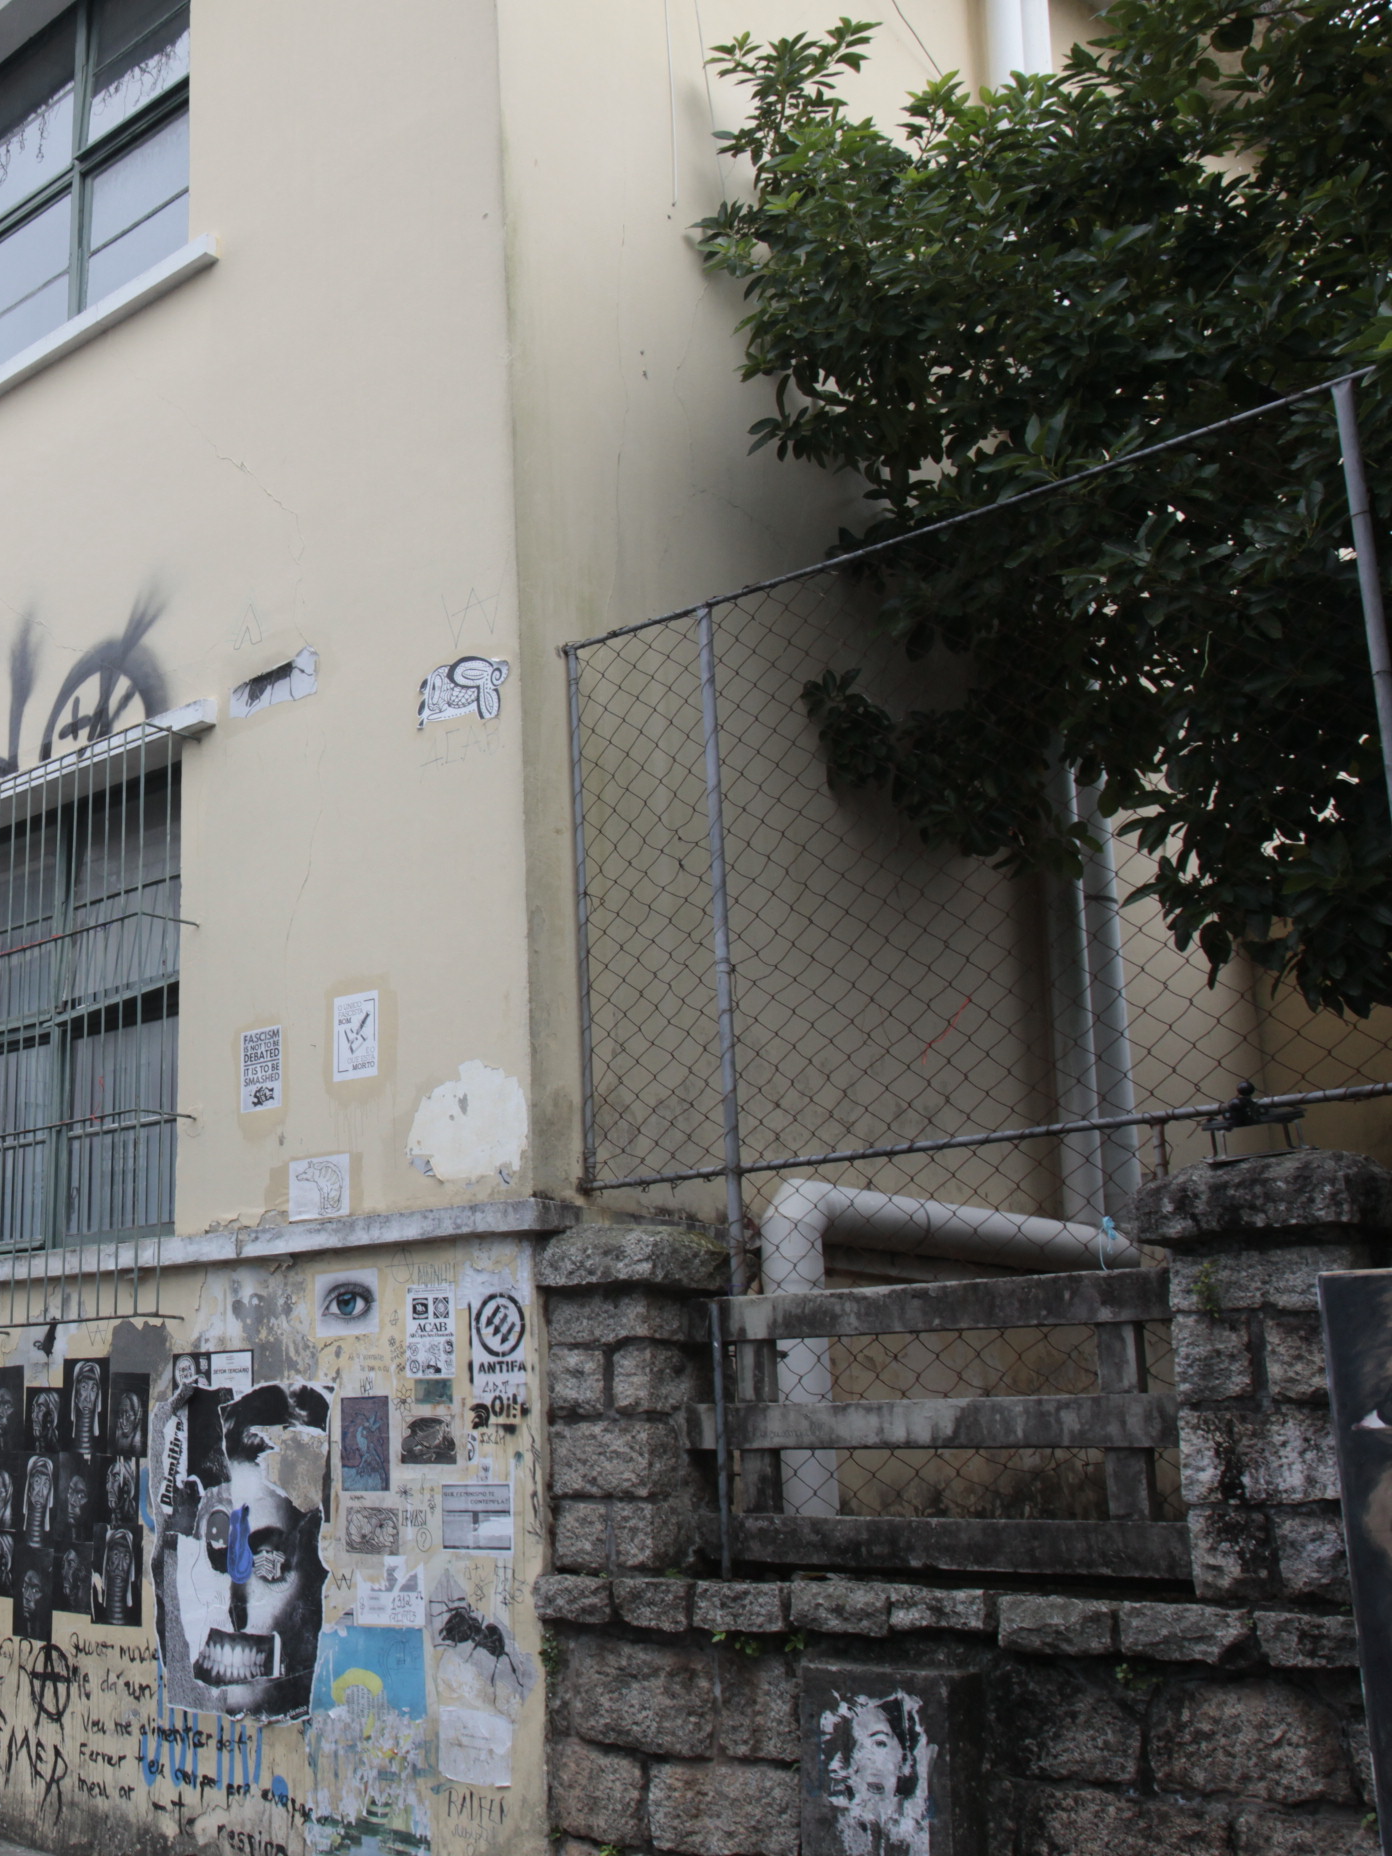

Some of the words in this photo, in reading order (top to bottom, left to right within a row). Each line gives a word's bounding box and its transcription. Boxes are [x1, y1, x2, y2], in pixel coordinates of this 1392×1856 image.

[338, 1017, 352, 1025] BOM
[244, 1027, 280, 1045] FASCISM
[251, 1043, 262, 1052] NOT
[263, 1041, 272, 1049] TO
[273, 1039, 280, 1047] BE
[244, 1047, 280, 1064] DEBATED
[244, 1067, 249, 1077] IT
[251, 1066, 258, 1075] IS
[260, 1064, 269, 1074] TO
[271, 1062, 280, 1072] BE
[352, 1060, 375, 1070] MORTO
[244, 1072, 280, 1088] SMASHED
[415, 1322, 447, 1334] ACAB
[478, 1360, 526, 1374] ANTIFA
